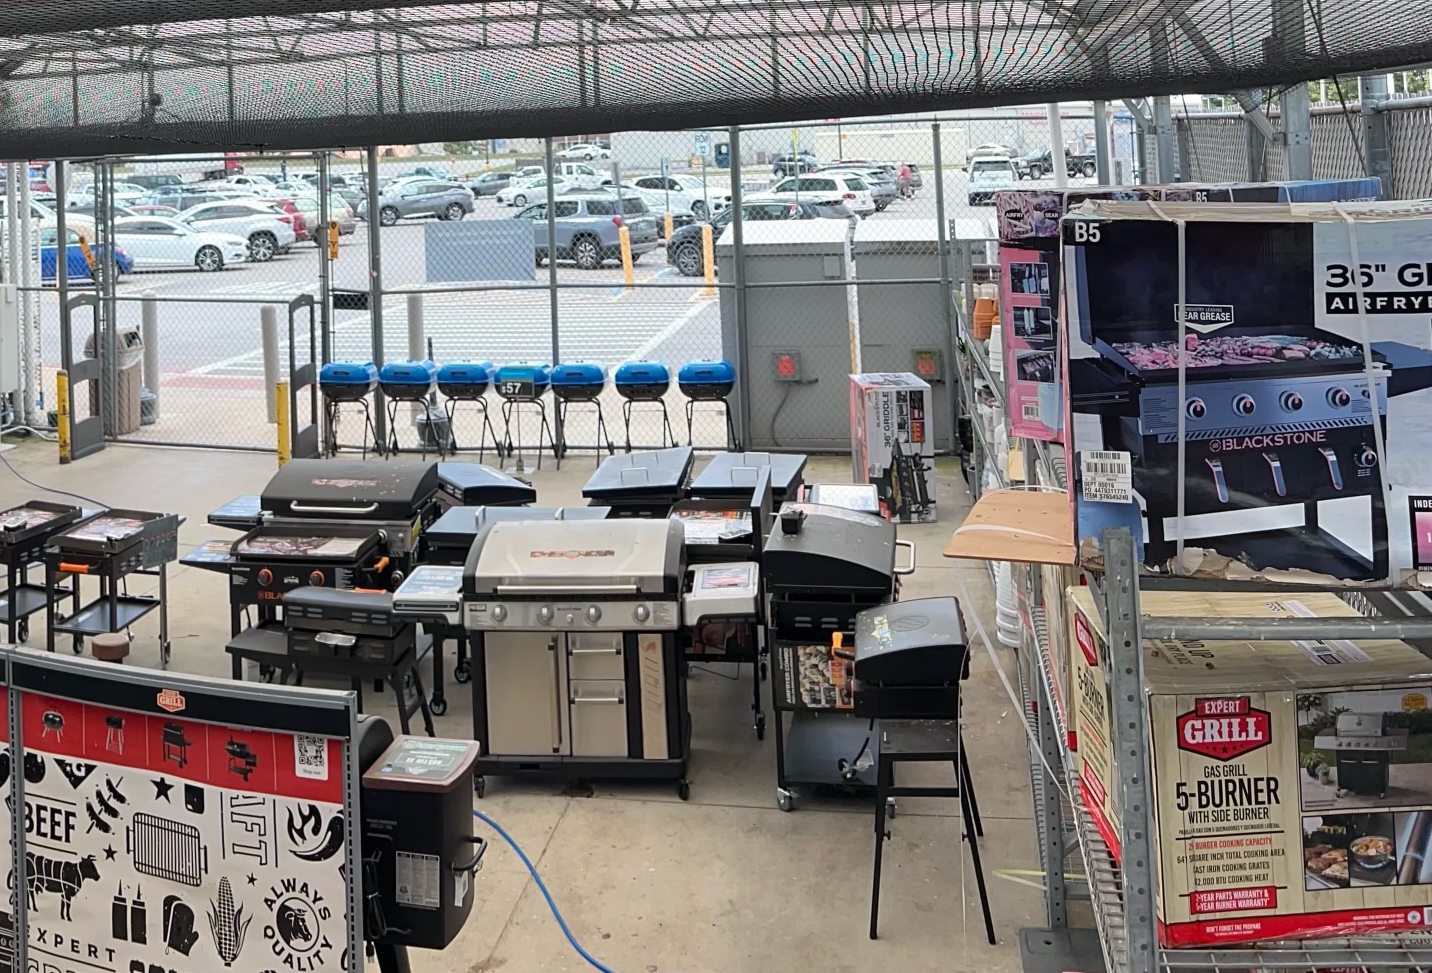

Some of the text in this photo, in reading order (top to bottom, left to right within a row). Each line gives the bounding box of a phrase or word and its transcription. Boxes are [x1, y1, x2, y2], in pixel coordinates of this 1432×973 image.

[1196, 191, 1208, 203] B5
[1074, 221, 1101, 243] B5
[1325, 263, 1386, 288] 36"
[1184, 311, 1231, 321] EAR GREASE
[882, 390, 891, 431] GRIDDLE
[1222, 430, 1327, 451] BLACKSTONE
[159, 696, 183, 707] GRILL
[1204, 700, 1240, 714] EXPERT
[1184, 717, 1263, 744] GRILL
[73, 762, 86, 776] G
[1203, 763, 1248, 778] GAS GRILL
[1176, 776, 1281, 811] 5-BURNER
[24, 801, 77, 844] BEEF
[1188, 806, 1270, 824] WITH SIDE BURNER
[1195, 840, 1218, 851] BURGER
[1218, 839, 1245, 849] COOKING
[1245, 837, 1273, 847] CAPACITY
[1210, 852, 1225, 862] INCH
[1225, 850, 1243, 860] TOTAL
[1243, 849, 1269, 859] COOKING
[1270, 848, 1286, 858] AREA
[1193, 861, 1270, 874] CAST IRON COOKING GRATES
[1215, 876, 1227, 886] BTU
[1227, 874, 1254, 884] COOKING
[1254, 872, 1269, 883] HEAT
[262, 877, 333, 923] ALWAYS
[1195, 888, 1269, 903] 2-YEAR PARTS WARRANTY &
[1195, 900, 1215, 912] 5-YEAR
[1215, 899, 1238, 910] BURNER
[1242, 922, 1261, 930] PROPANE
[262, 923, 333, 973] QUALITY
